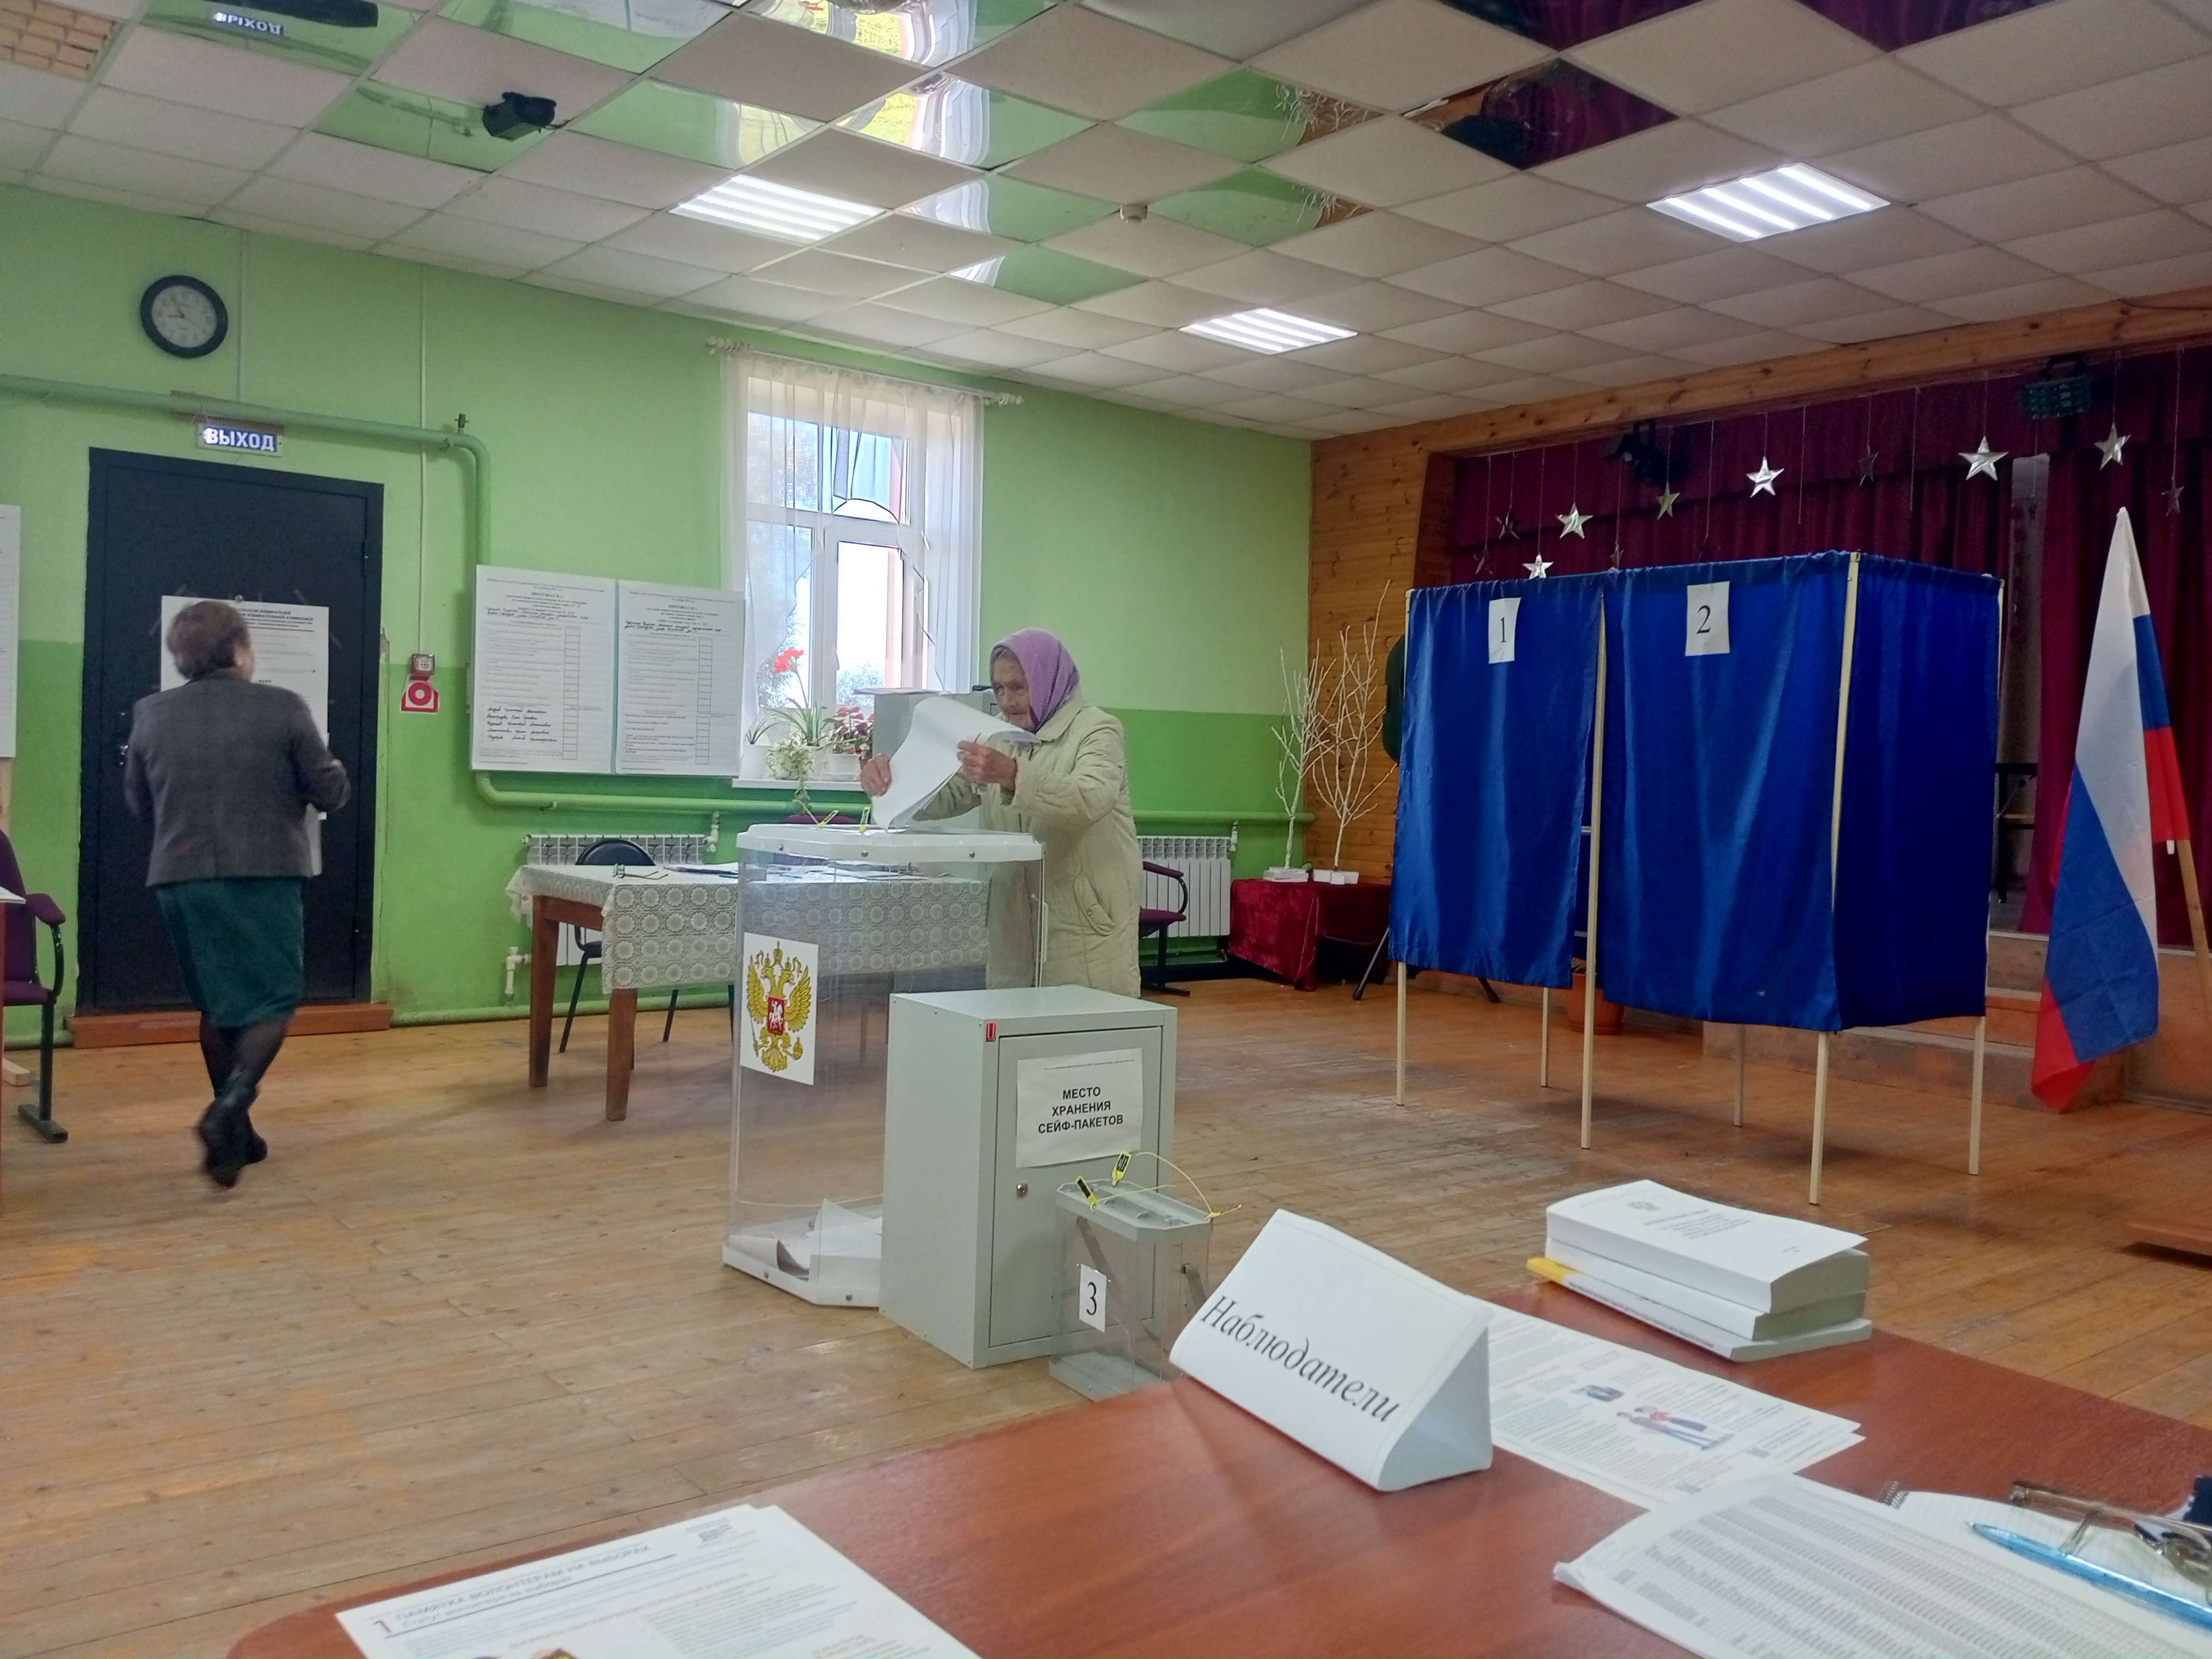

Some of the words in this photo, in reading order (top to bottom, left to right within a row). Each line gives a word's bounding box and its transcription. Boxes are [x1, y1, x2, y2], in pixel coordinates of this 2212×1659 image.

[205, 428, 274, 451] ВЫХОД
[1500, 617, 1507, 643] 1
[1696, 605, 1711, 634] 2
[1062, 1086, 1101, 1099] МЕСТО
[1052, 1101, 1111, 1116] ХРАНЕНИЯ
[1038, 1115, 1123, 1134] СЕЙФ-ПАКЕТОВ
[1086, 1281, 1097, 1315] 3
[1201, 1295, 1400, 1422] Наблюдатели
